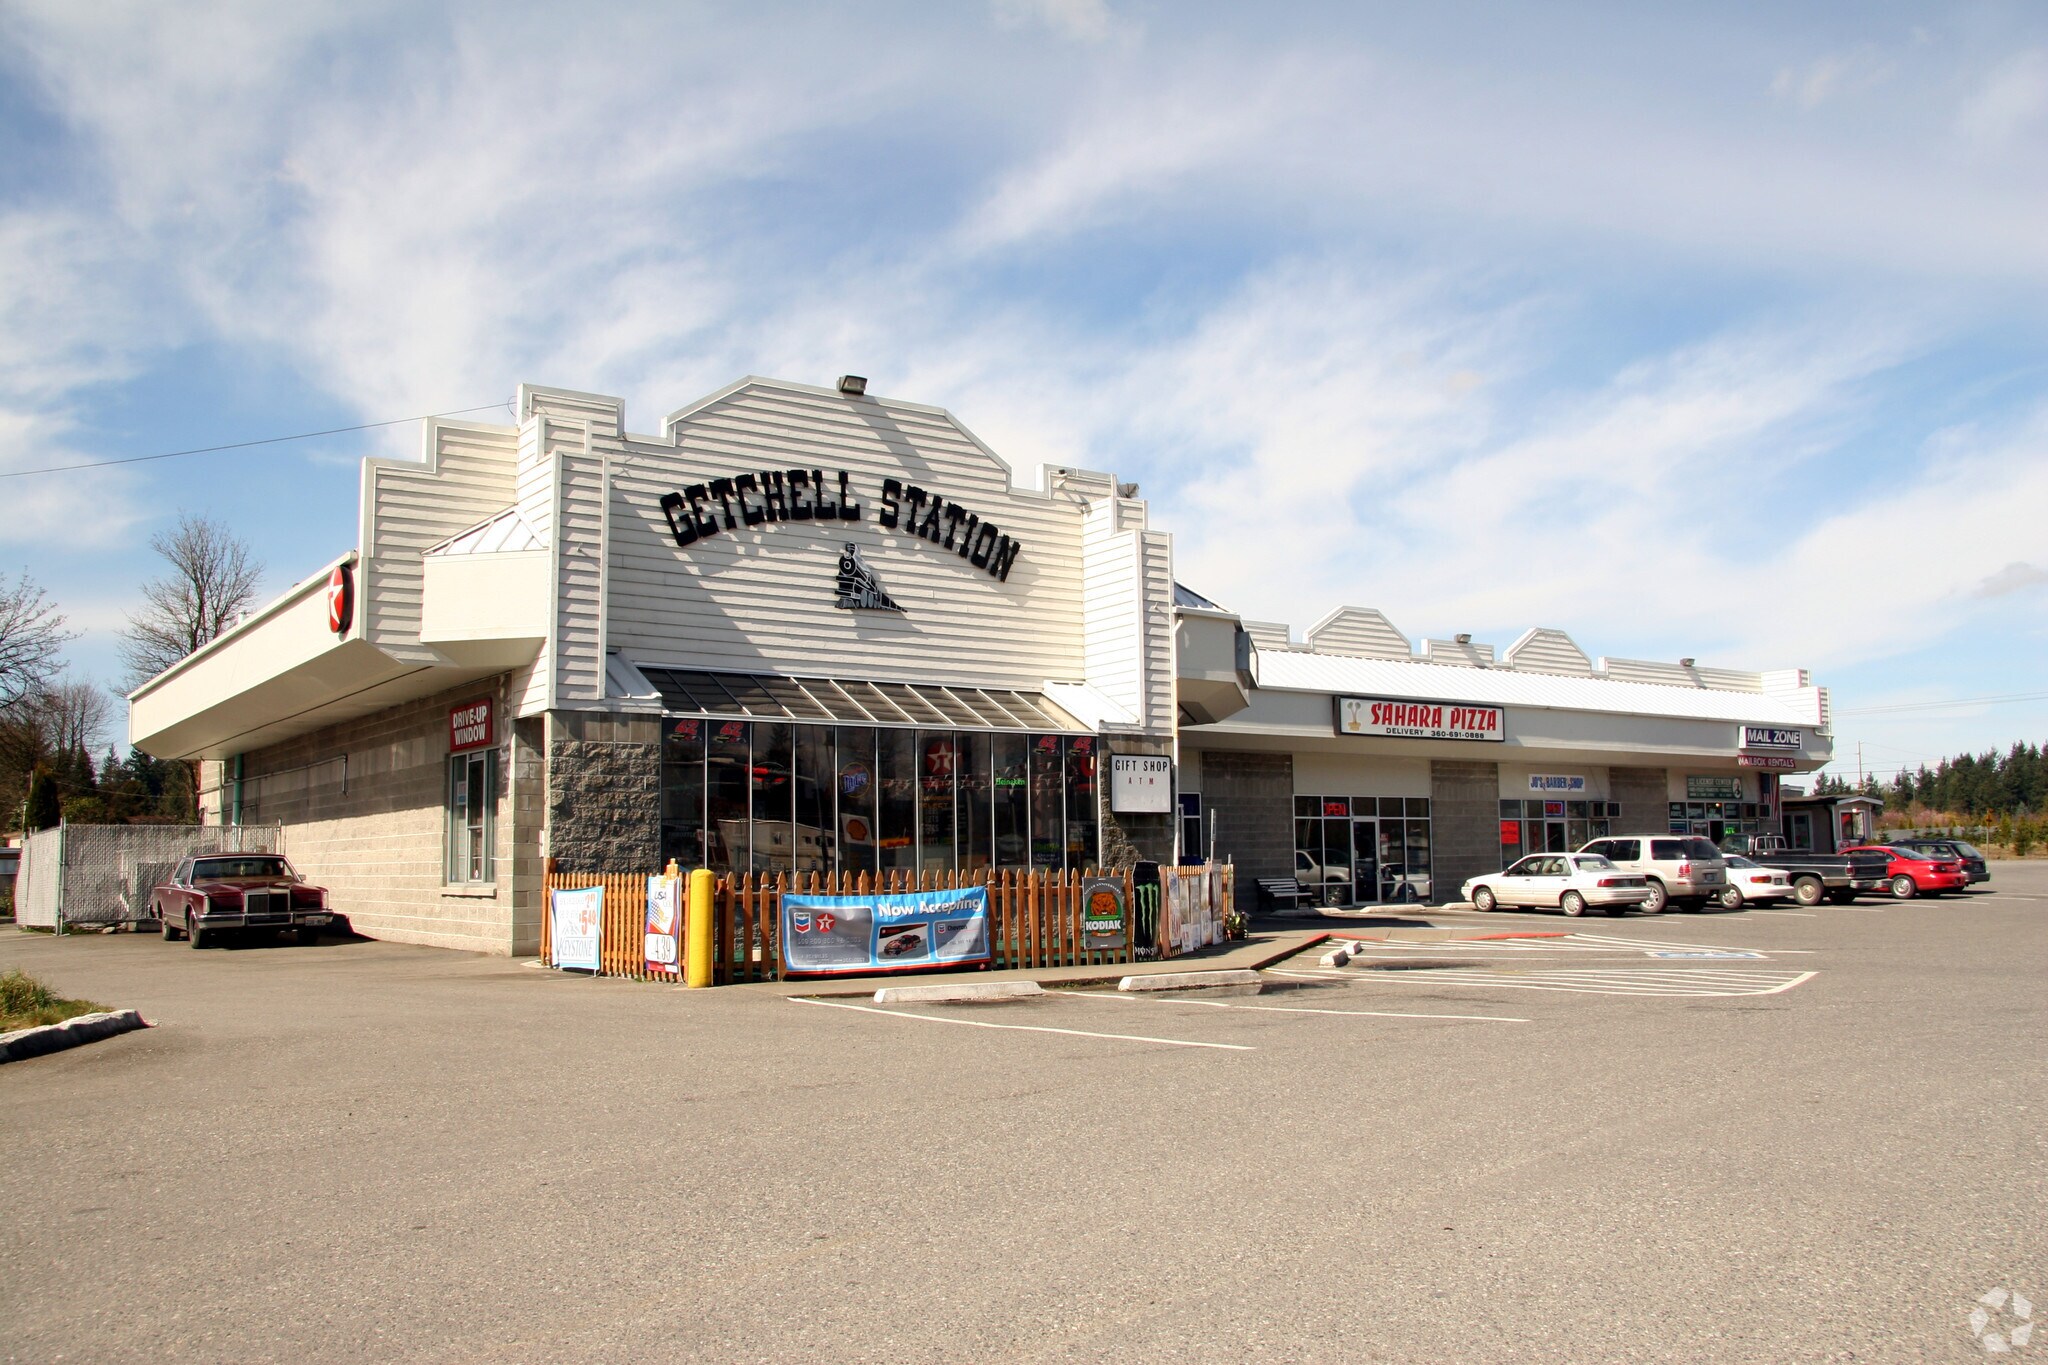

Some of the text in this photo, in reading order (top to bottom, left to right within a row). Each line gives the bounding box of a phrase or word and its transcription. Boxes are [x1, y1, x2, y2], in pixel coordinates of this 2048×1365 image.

[659, 469, 1021, 583] GETCHELL STATION
[453, 705, 487, 729] DRIVE-UP
[1371, 702, 1497, 731] SAHARA PIZZA
[454, 723, 486, 745] WINDOW
[674, 720, 700, 735] 42
[719, 721, 745, 736] 42
[1386, 727, 1424, 736] DELIVERY
[1038, 735, 1058, 749] 42
[1073, 736, 1093, 750] 42
[1747, 728, 1800, 744] MAIL ZONE
[1115, 759, 1168, 772] GIFT SHOP
[1738, 756, 1795, 768] MAILBOX RENTALS
[878, 903, 915, 917] Now
[1085, 920, 1122, 931] KODIAK
[559, 937, 593, 958] KEYSTONE
